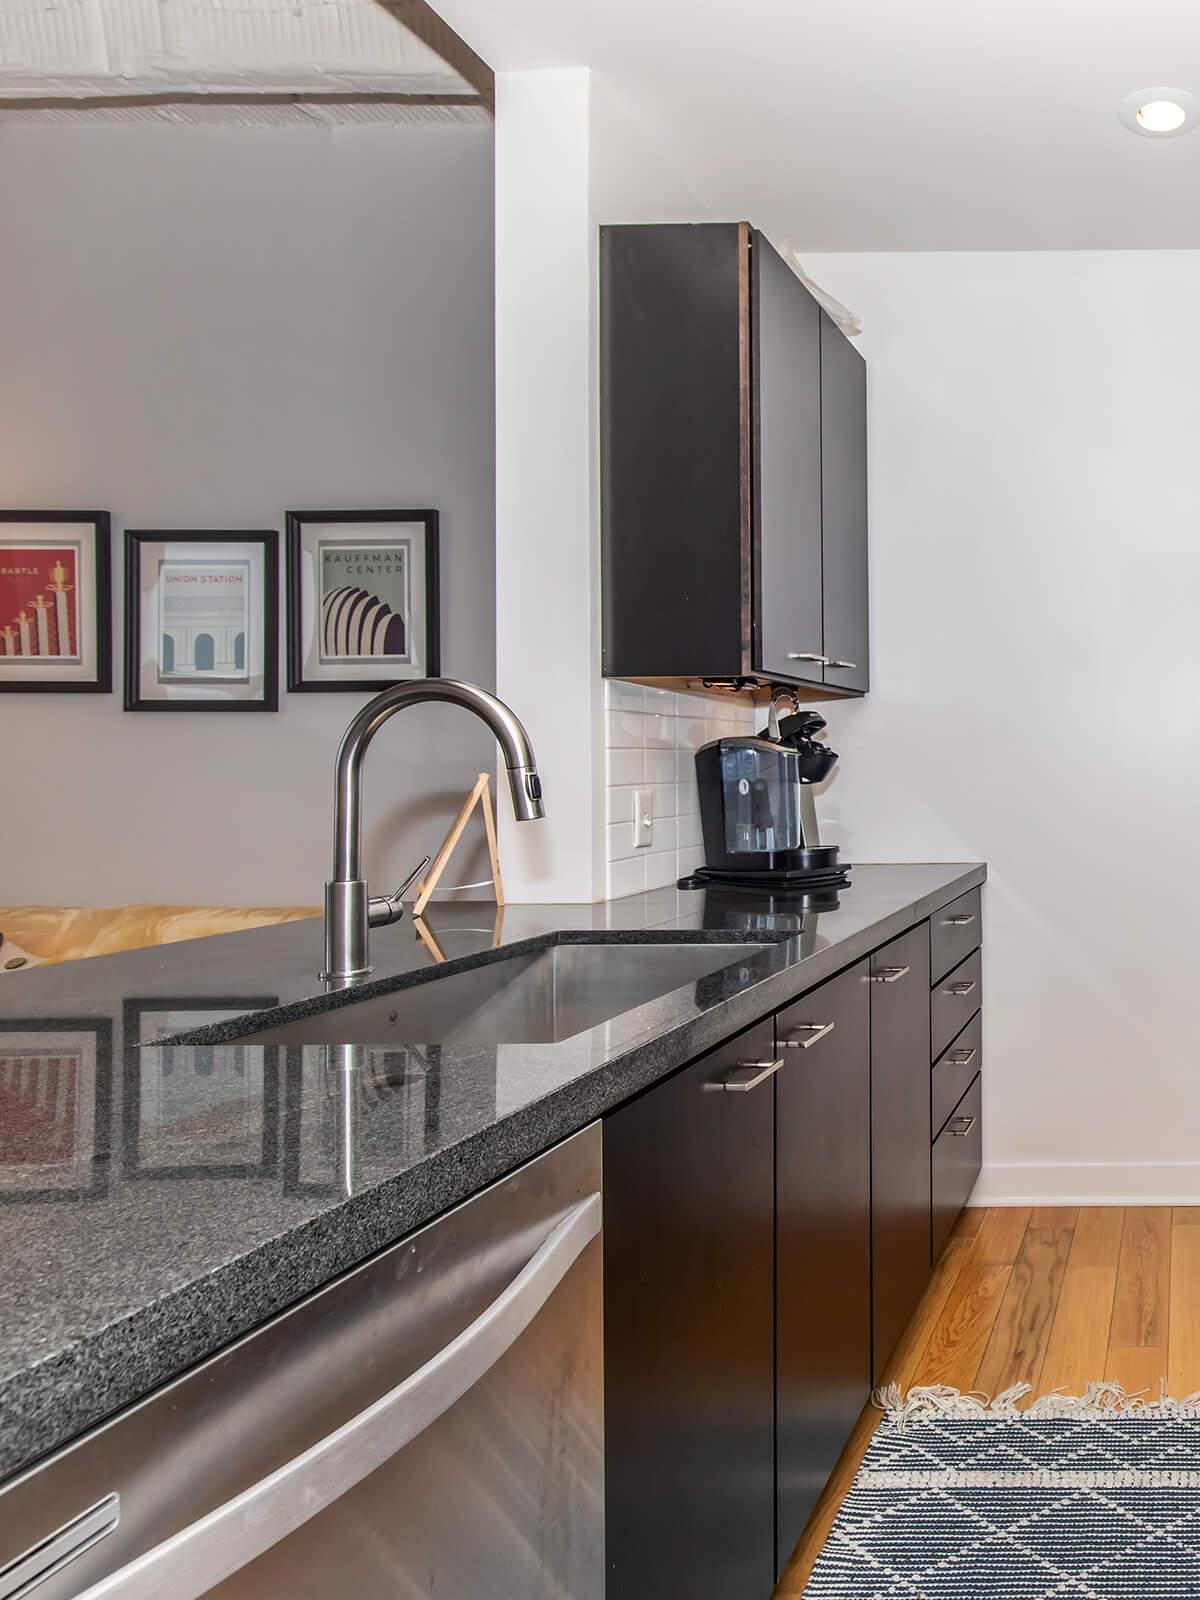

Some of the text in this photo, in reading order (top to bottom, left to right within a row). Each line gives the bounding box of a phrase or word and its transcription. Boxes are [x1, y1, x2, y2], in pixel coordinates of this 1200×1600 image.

[323, 553, 402, 562] KAUFFMAN
[345, 565, 402, 574] CENTER
[166, 575, 242, 584] UNION STATION
